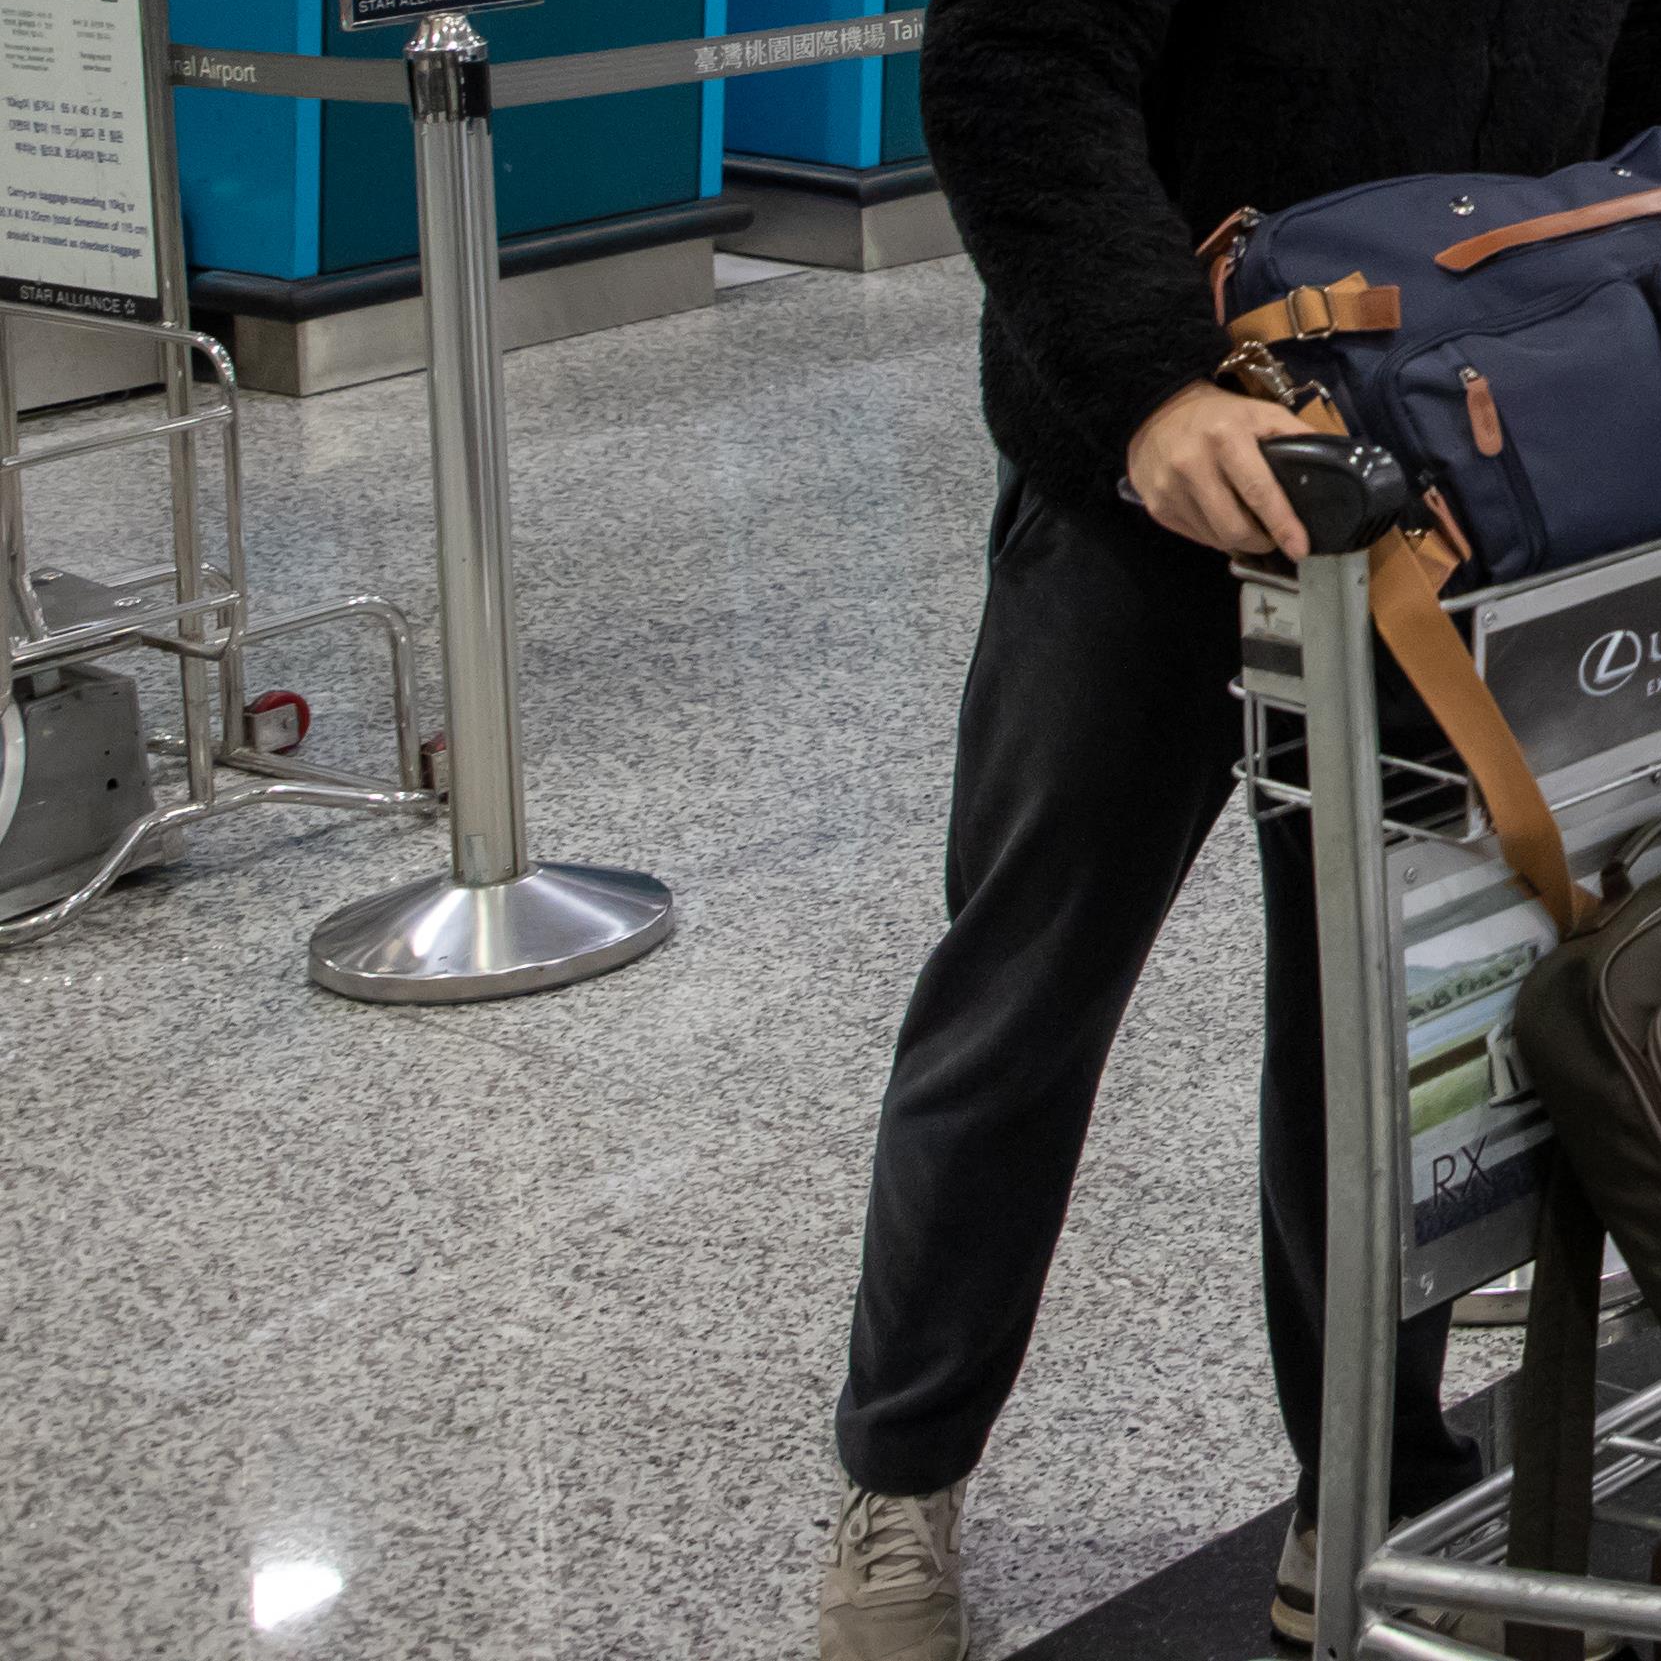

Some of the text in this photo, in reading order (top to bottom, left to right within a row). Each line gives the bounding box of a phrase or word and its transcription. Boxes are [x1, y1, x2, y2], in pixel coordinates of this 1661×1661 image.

[693, 22, 887, 76] 臺灣桃園國際機場
[199, 55, 257, 88] Airport
[20, 285, 122, 315] STAR ALLIANCE
[1431, 1134, 1496, 1209] RX
